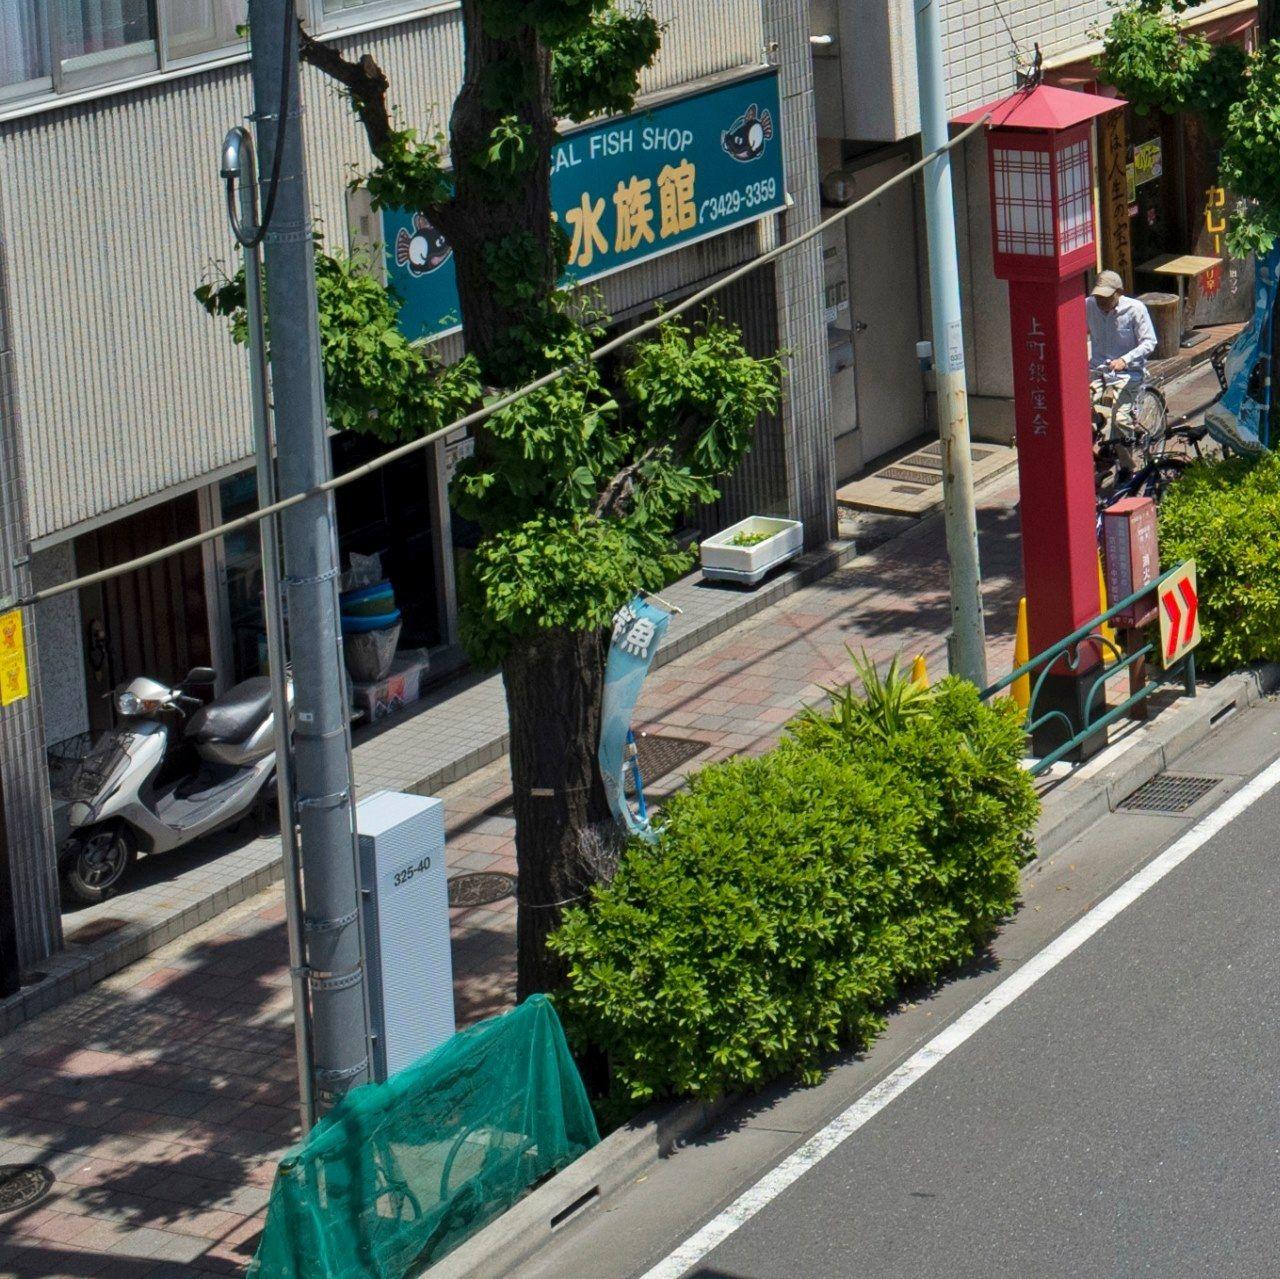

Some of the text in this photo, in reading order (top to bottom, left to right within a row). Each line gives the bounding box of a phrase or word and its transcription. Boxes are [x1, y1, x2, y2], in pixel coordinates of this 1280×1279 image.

[590, 129, 633, 160] FISH
[641, 126, 694, 153] SHOP
[708, 176, 777, 221] 3429-3359
[394, 856, 431, 887] 325-40
